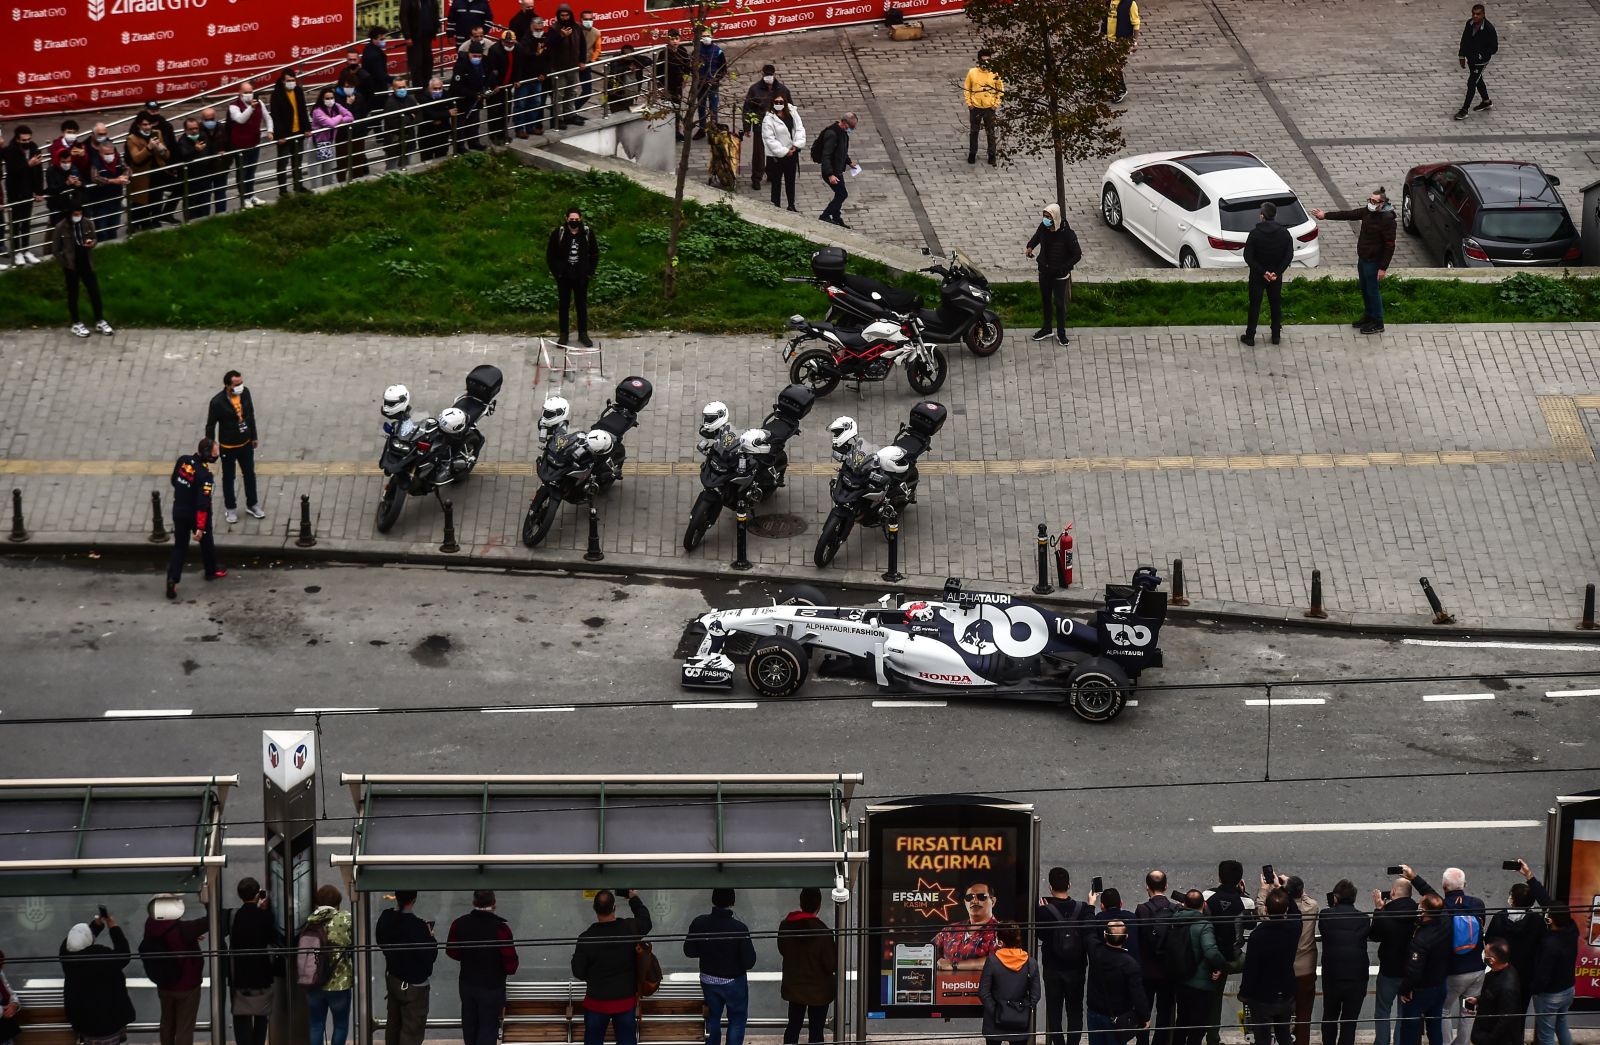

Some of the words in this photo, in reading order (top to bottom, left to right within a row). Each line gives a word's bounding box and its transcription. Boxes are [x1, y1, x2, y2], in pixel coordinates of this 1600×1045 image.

[947, 592, 1011, 604] ALPHATAURI
[805, 623, 885, 638] ALPHATAURI.FASHION
[1055, 617, 1074, 635] 10
[1106, 649, 1144, 657] ALPHATAURI
[918, 671, 972, 683] HONDA
[896, 836, 1003, 852] FIRSATLARI
[907, 854, 992, 873] KAÇIRMA
[893, 892, 939, 902] EFSANE
